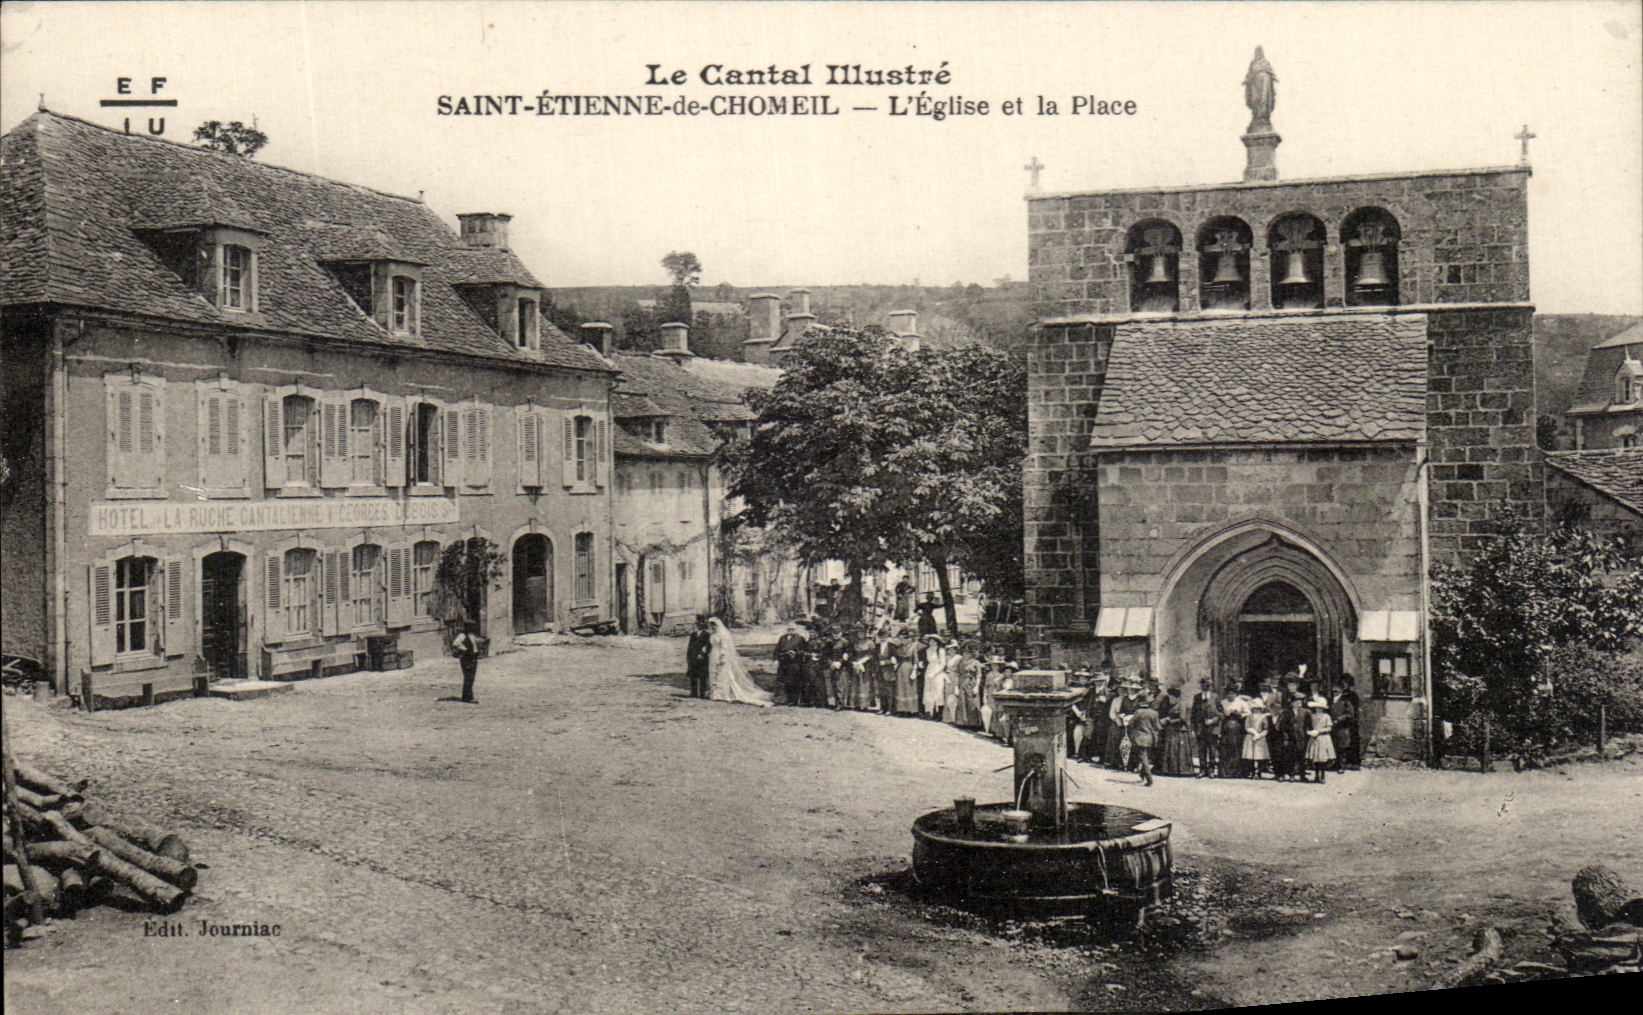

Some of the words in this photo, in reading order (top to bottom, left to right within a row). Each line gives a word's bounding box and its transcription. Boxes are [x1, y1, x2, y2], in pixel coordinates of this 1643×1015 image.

[98, 507, 148, 530] HOTEL
[164, 507, 182, 529] LA
[190, 506, 234, 527] RUCHE
